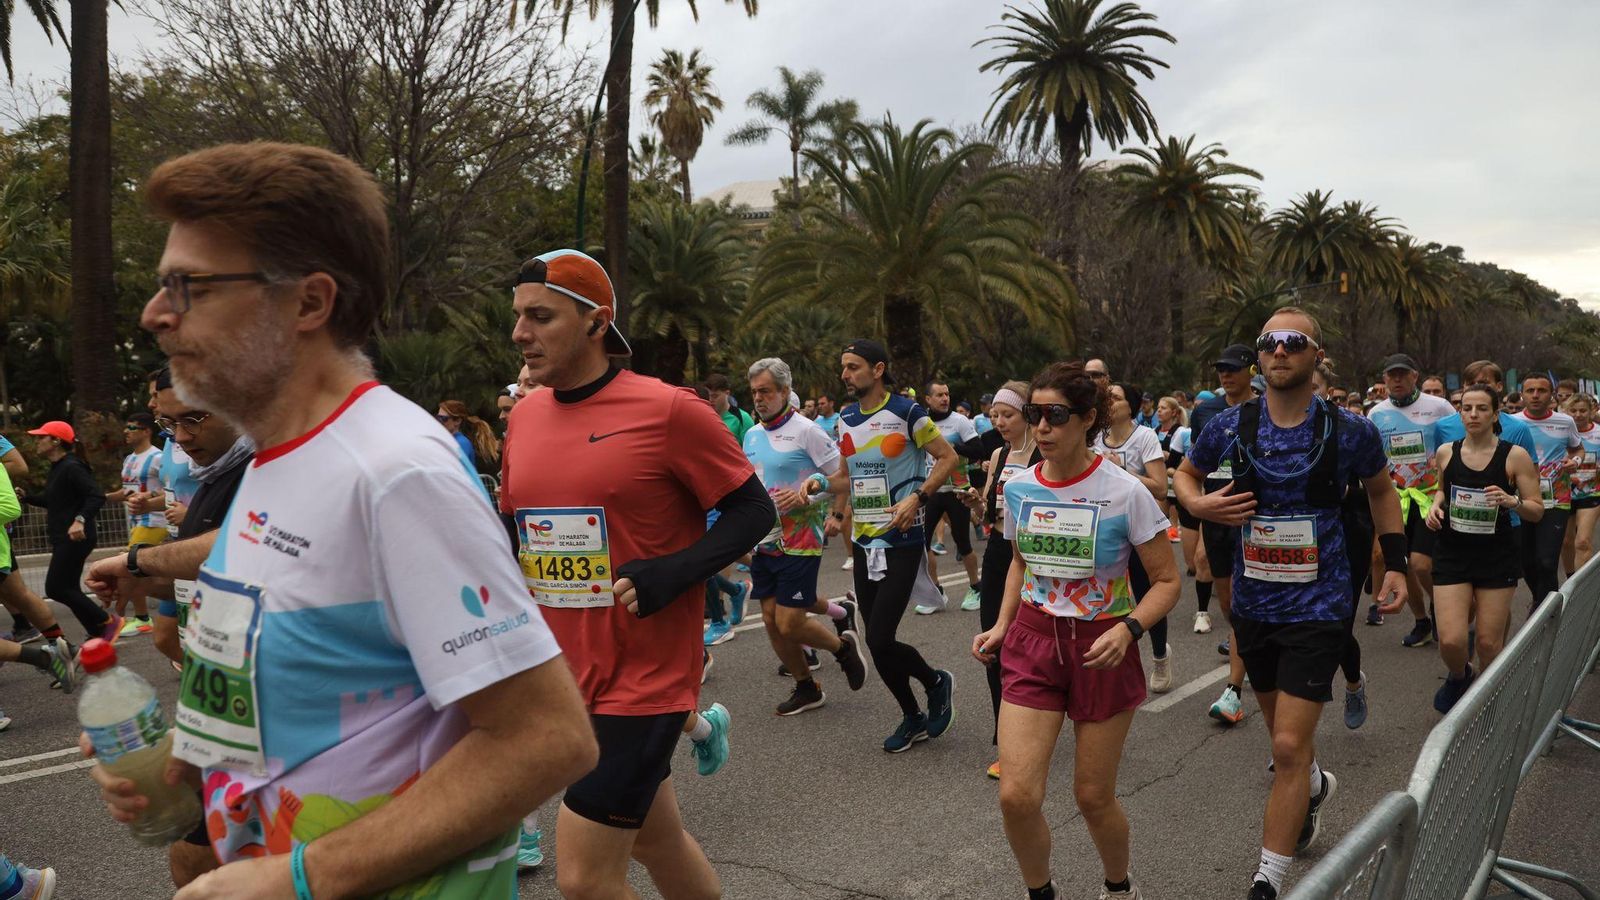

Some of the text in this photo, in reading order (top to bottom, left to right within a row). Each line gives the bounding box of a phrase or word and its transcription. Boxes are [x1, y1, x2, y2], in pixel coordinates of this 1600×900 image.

[856, 461, 885, 470] Málaga
[856, 495, 882, 508] 4995
[1032, 535, 1080, 556] 5332
[1259, 548, 1304, 565] 6658
[533, 556, 592, 581] 1483
[441, 609, 529, 656] quirónsalud
